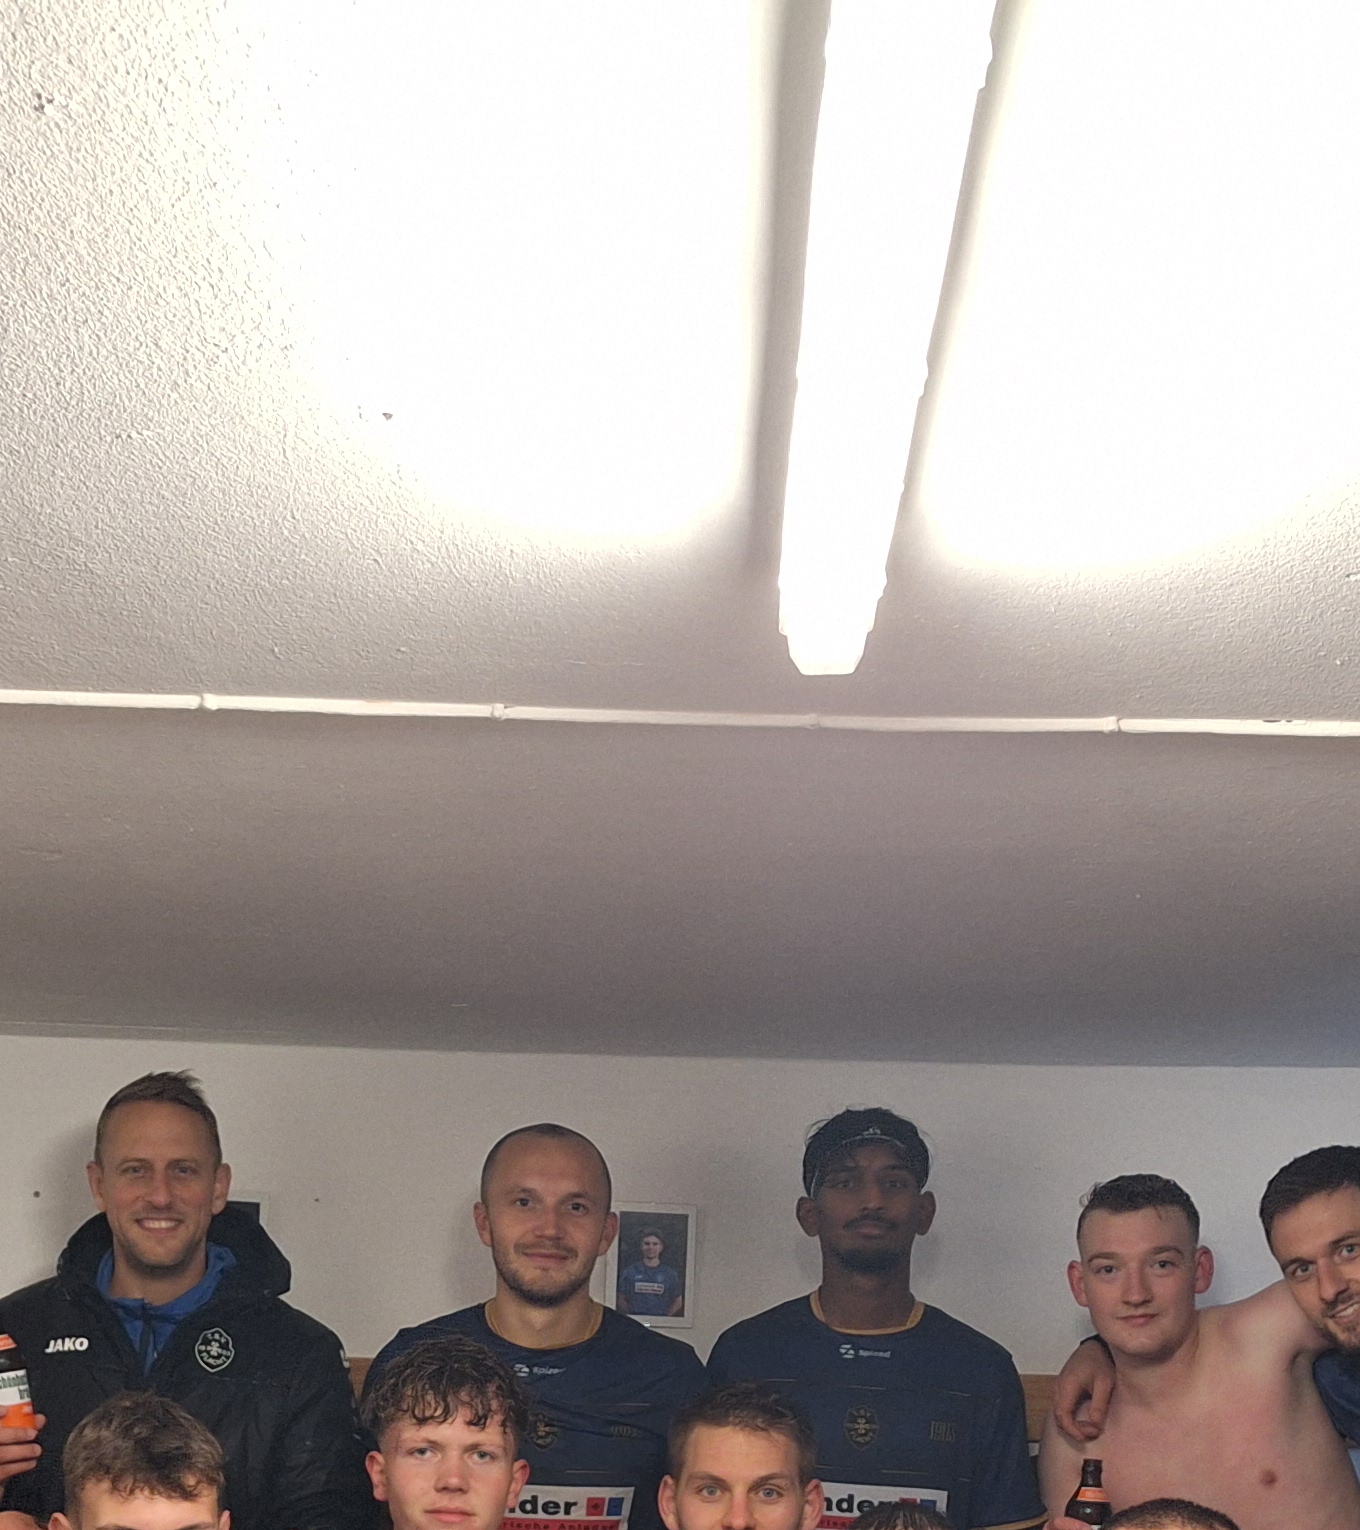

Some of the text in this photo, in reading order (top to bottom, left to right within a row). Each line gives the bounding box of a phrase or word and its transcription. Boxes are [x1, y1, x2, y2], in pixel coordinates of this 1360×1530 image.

[45, 1337, 89, 1353] JAKO
[508, 1495, 578, 1516] der
[502, 1521, 551, 1530] rische
